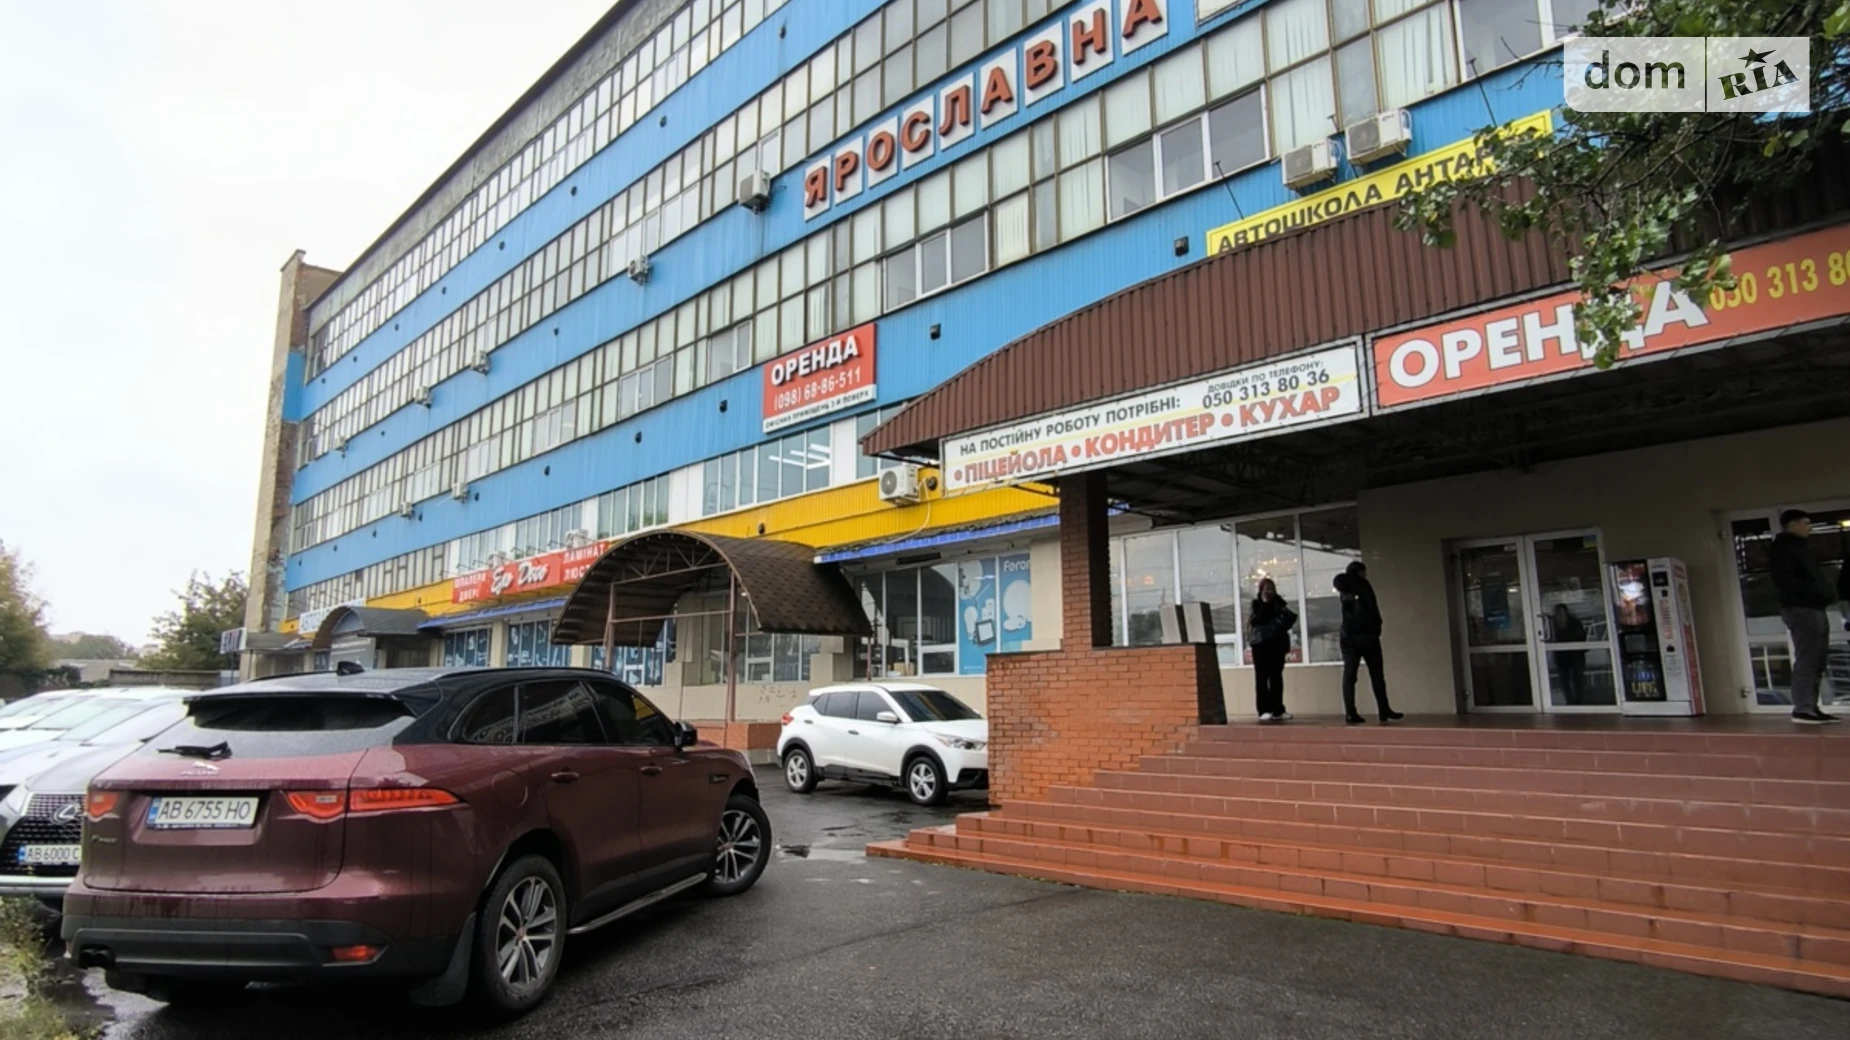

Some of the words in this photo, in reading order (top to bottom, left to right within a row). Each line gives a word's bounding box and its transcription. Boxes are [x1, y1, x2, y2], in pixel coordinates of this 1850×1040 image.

[805, 0, 1162, 208] ЯРОСЛАВНА
[1217, 185, 1383, 252] АВТОШКОЛА
[1767, 258, 1819, 300] 313
[1827, 249, 1850, 287] 8
[771, 335, 859, 385] ОРЕНДА
[1207, 376, 1249, 393] ДОВІДКИ
[1252, 373, 1266, 383] ПО
[1269, 361, 1324, 378] ТЕЛЕФОНУ:
[774, 387, 802, 411] (098)
[804, 366, 861, 401] 68-86-511
[1202, 390, 1233, 409] 050
[1239, 382, 1270, 401] 313
[1277, 375, 1299, 393] 80
[1307, 368, 1330, 386] 36
[960, 443, 976, 456] НА
[980, 427, 1041, 452] ПОСТІЙНУ
[1046, 413, 1101, 436] РОБОТУ
[1106, 396, 1181, 424] ПОТРІБНІ:
[965, 445, 1068, 483] ПІЦЕЙОЛА
[1085, 412, 1215, 459] КОНДИТЕР
[1239, 386, 1340, 427] КУХАР
[159, 801, 182, 819] AB
[184, 801, 224, 819] 6755
[225, 801, 251, 819] HO
[27, 848, 41, 859] AB
[43, 848, 70, 859] 6000
[72, 848, 80, 859] C
